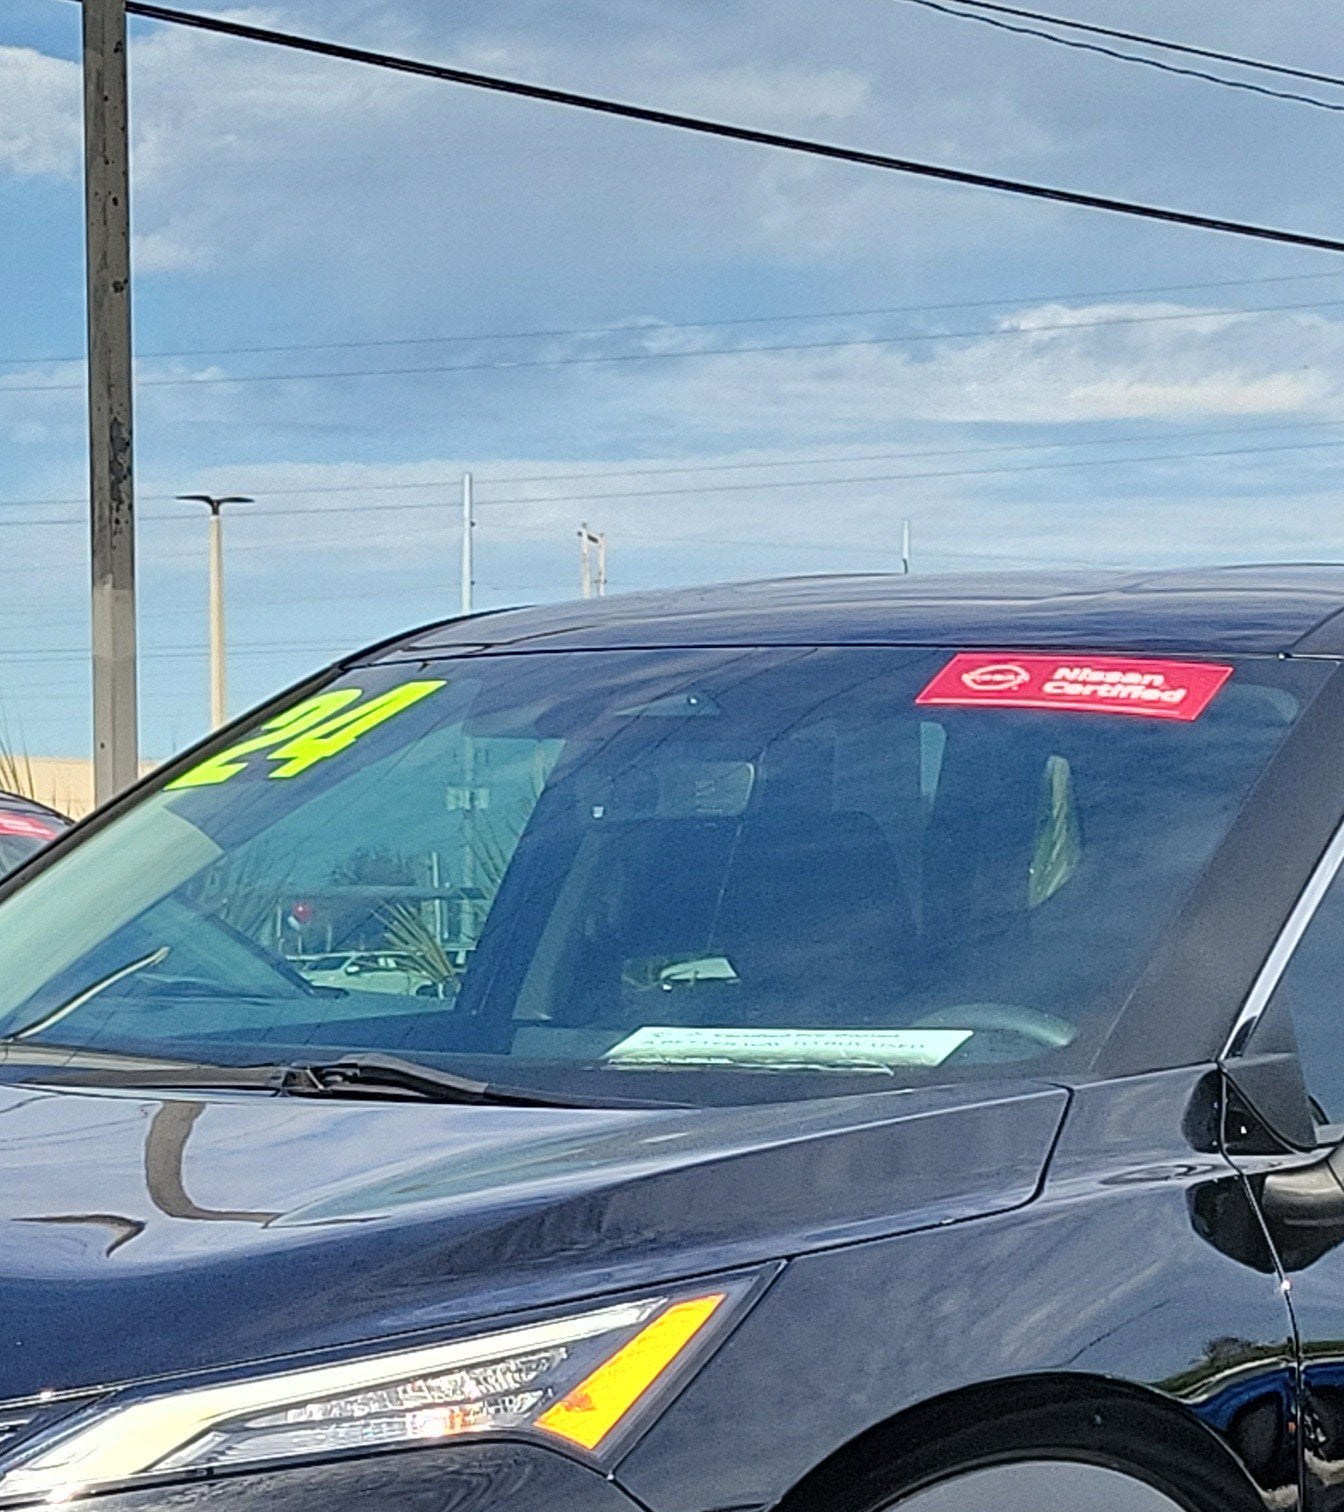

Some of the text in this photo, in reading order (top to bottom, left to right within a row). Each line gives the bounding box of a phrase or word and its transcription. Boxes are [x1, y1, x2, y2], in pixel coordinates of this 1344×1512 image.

[1053, 667, 1164, 687] Nissan
[1043, 681, 1188, 703] Certified
[163, 679, 448, 791] 24
